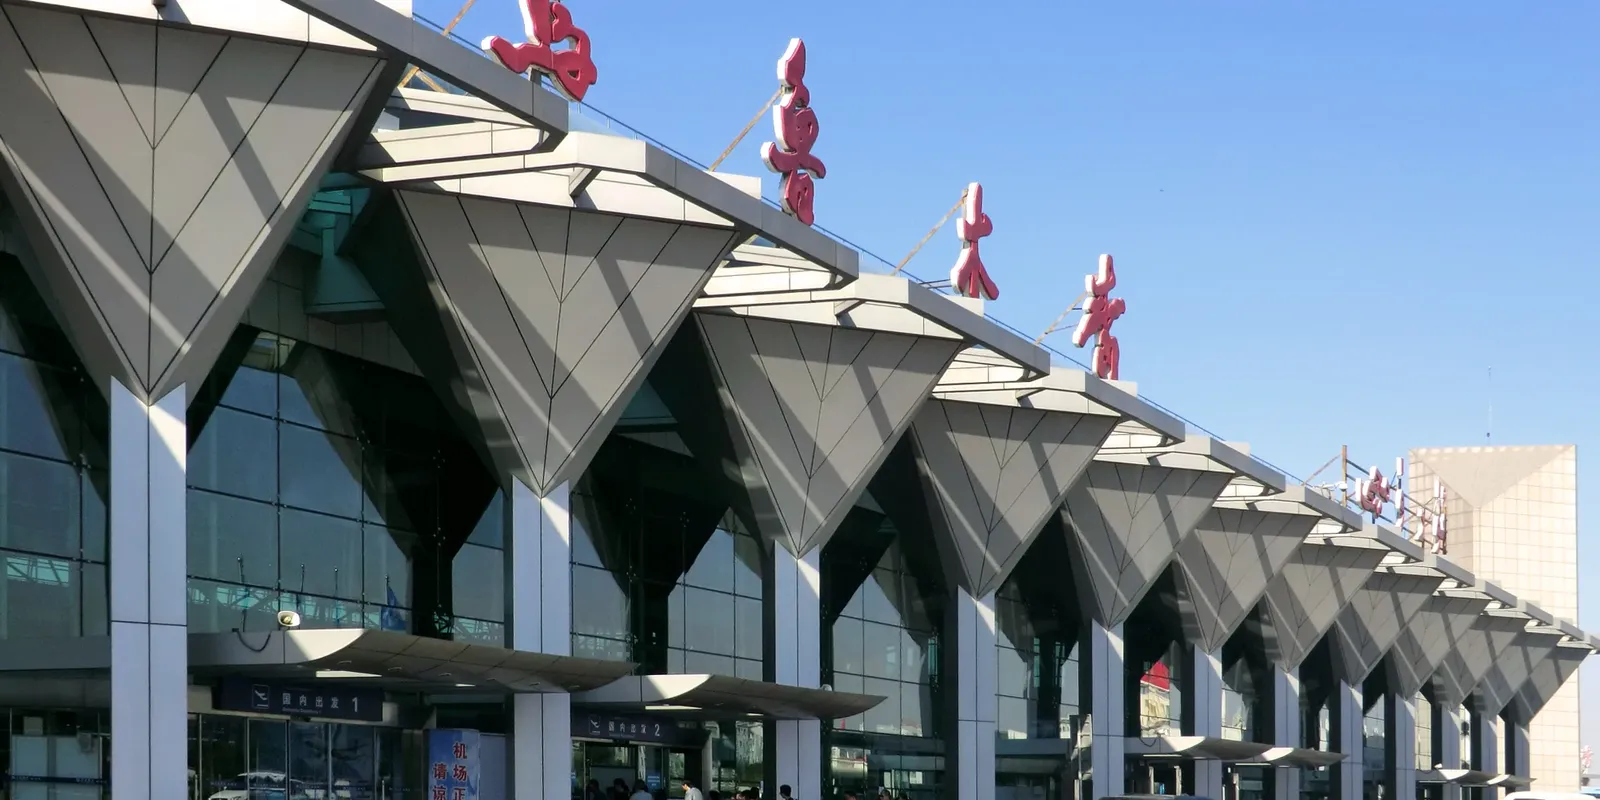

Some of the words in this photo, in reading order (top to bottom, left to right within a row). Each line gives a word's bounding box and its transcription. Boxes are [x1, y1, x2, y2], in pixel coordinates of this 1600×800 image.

[282, 692, 339, 709] 国内出发
[352, 697, 358, 713] 1
[654, 723, 660, 737] 2
